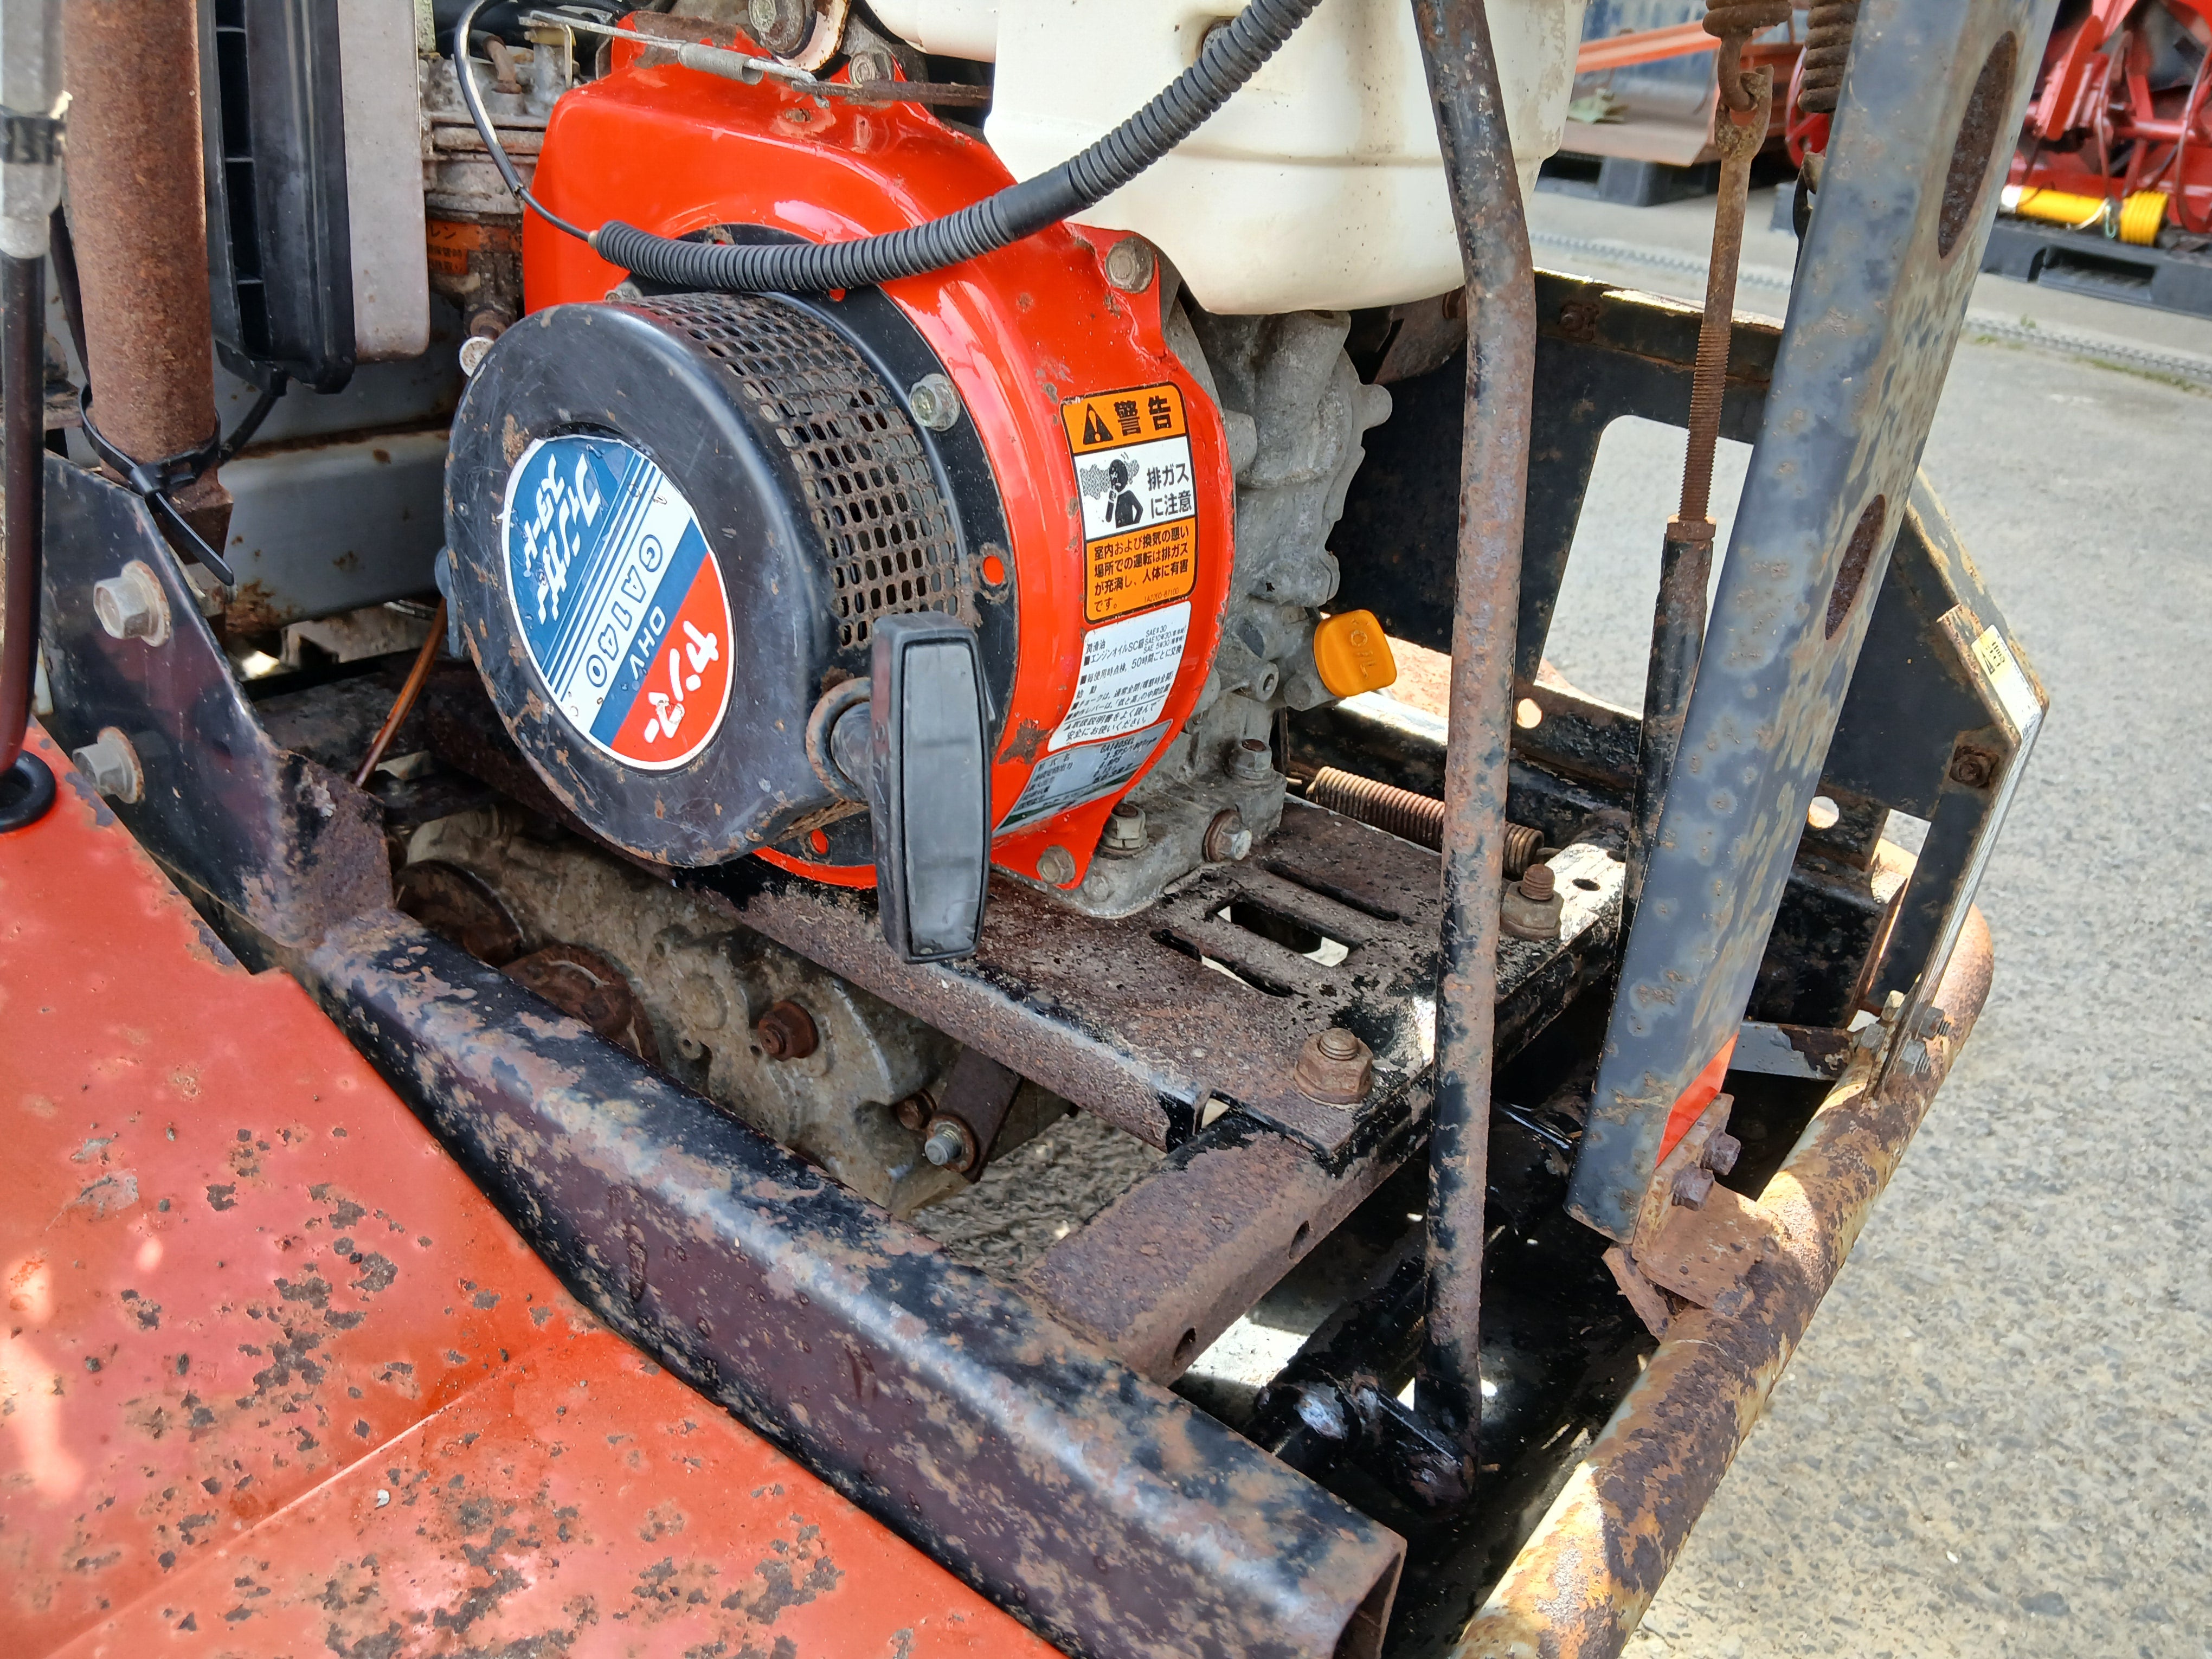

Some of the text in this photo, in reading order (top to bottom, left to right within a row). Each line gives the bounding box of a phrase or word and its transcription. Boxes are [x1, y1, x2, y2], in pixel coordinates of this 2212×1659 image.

[1114, 396, 1172, 436] 警告
[1147, 463, 1189, 492] 排ガス
[1150, 490, 1192, 519] に注意
[537, 453, 600, 625] フィンガー
[1094, 525, 1189, 561] 室内および換気の悪い
[1094, 542, 1188, 578] 場所での運転は排ガス
[1094, 559, 1188, 596] が充満し、人体に有害
[586, 534, 663, 688] GA140
[1094, 597, 1117, 613] です。
[629, 605, 667, 679] OHV
[1351, 629, 1376, 678] OIL
[644, 620, 719, 743] ヤンマー
